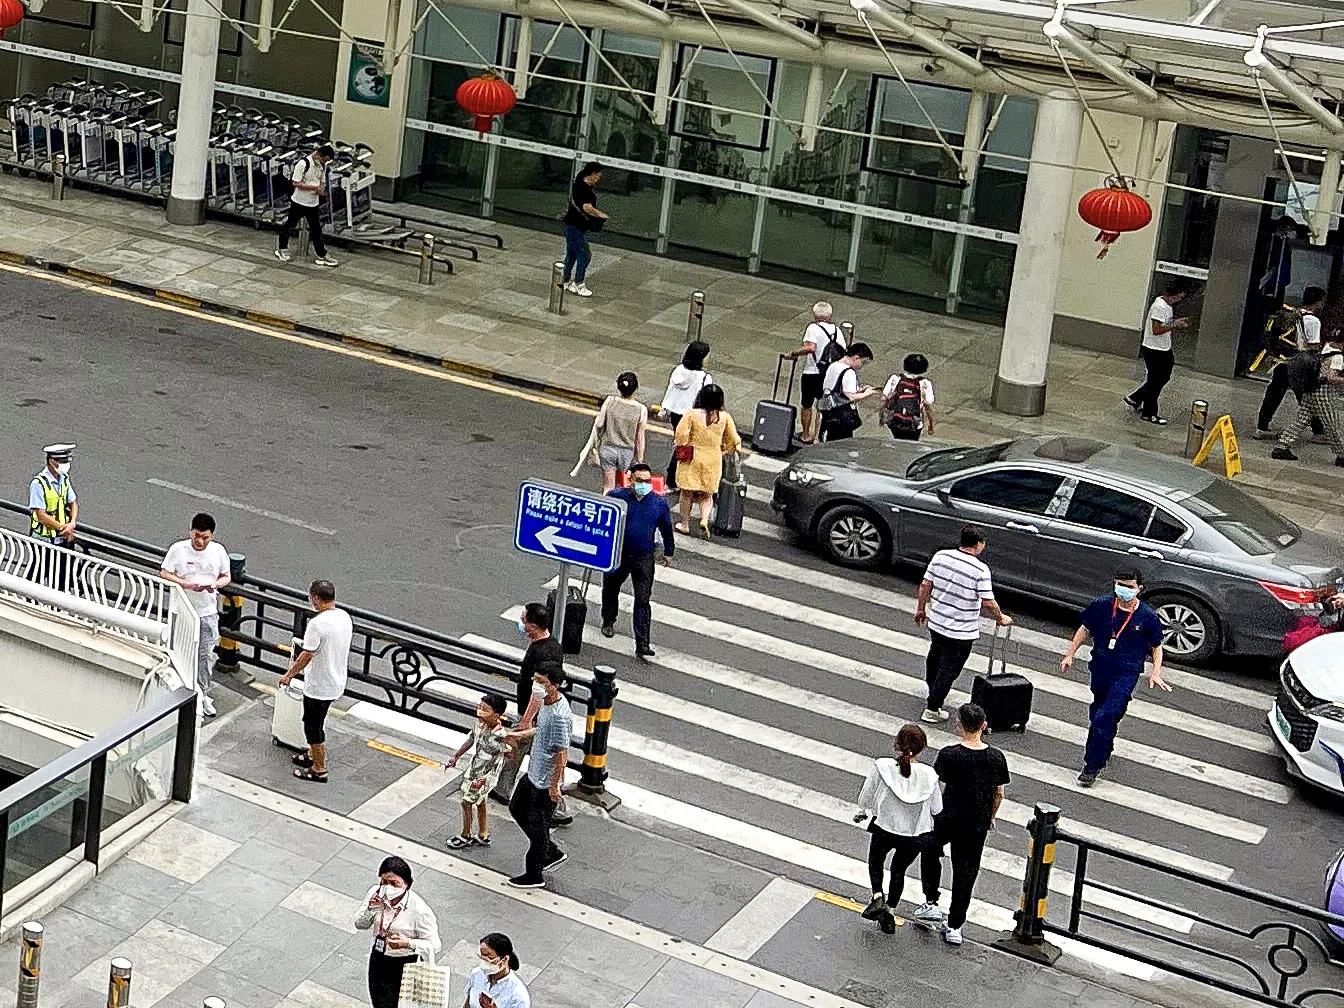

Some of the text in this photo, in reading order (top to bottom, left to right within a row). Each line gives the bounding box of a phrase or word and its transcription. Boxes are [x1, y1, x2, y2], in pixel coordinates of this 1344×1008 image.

[526, 508, 543, 518] Please
[527, 487, 613, 527] 请绕行4号门
